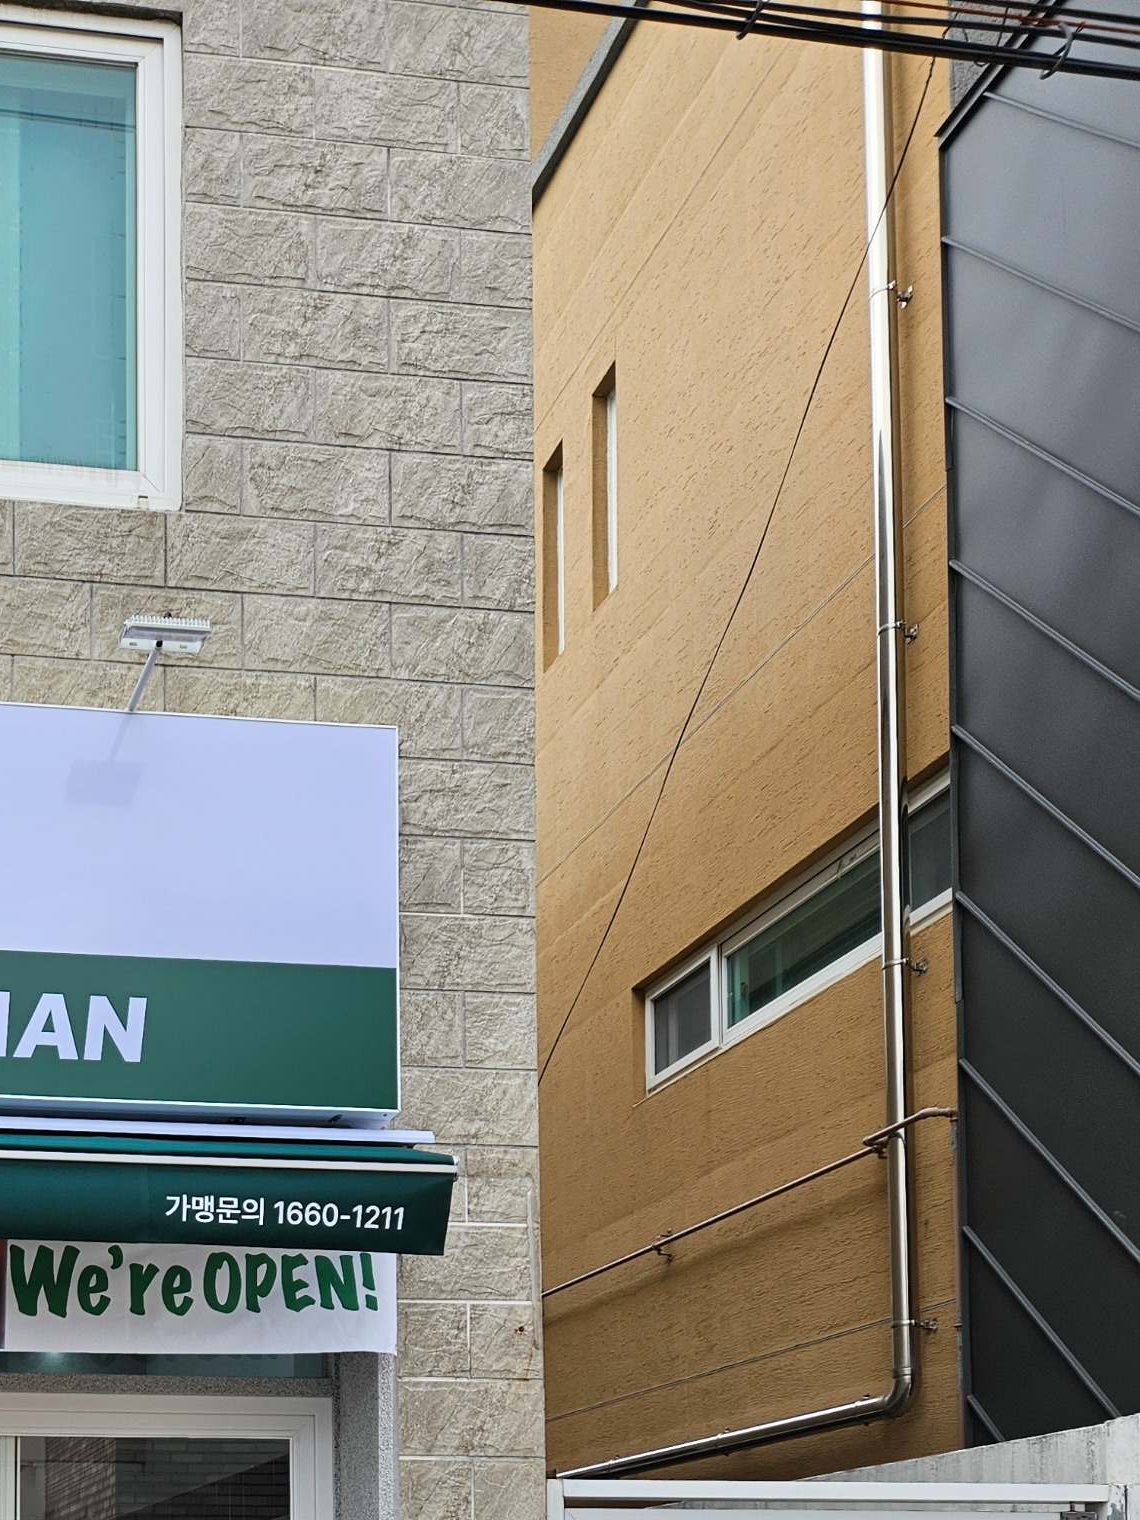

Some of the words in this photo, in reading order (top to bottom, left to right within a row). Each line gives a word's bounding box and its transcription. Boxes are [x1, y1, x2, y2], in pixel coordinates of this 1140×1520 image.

[165, 1192, 266, 1227] 가맹문의
[272, 1199, 405, 1231] 1660-1211
[8, 1244, 192, 1318] We're
[203, 1251, 379, 1315] OPEN!
